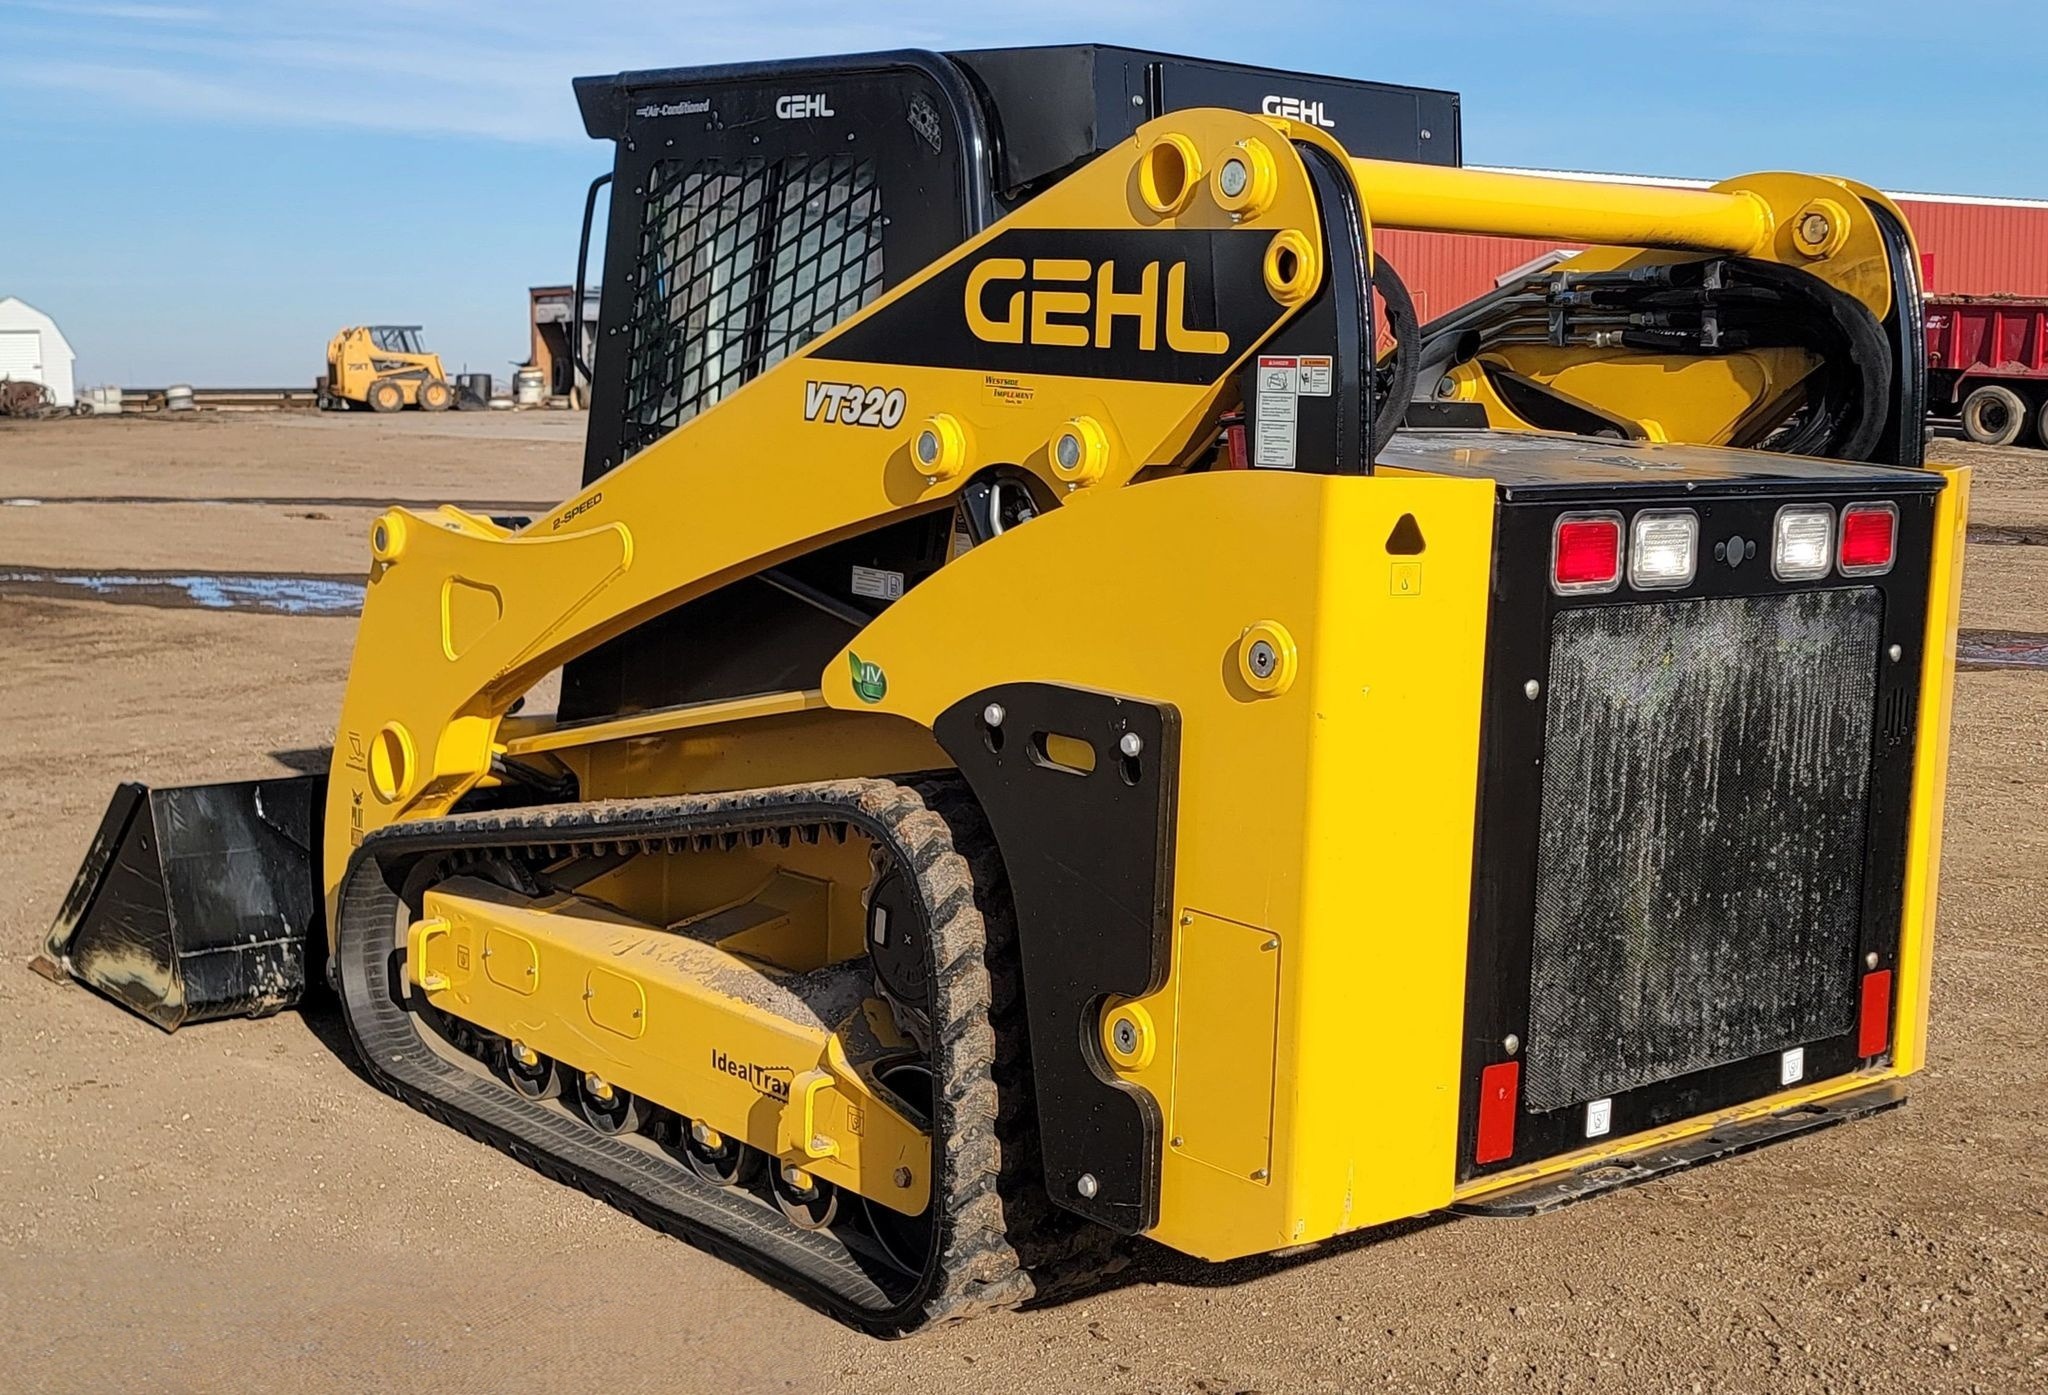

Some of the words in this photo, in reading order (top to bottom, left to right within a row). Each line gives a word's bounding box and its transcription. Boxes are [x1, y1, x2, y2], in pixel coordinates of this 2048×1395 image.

[776, 93, 834, 119] GEHL
[1262, 95, 1335, 127] GEHL
[964, 258, 1230, 354] GEHL
[804, 380, 906, 429] VT320
[552, 492, 602, 531] 2-SPEED
[712, 1048, 790, 1096] IdealTrax
